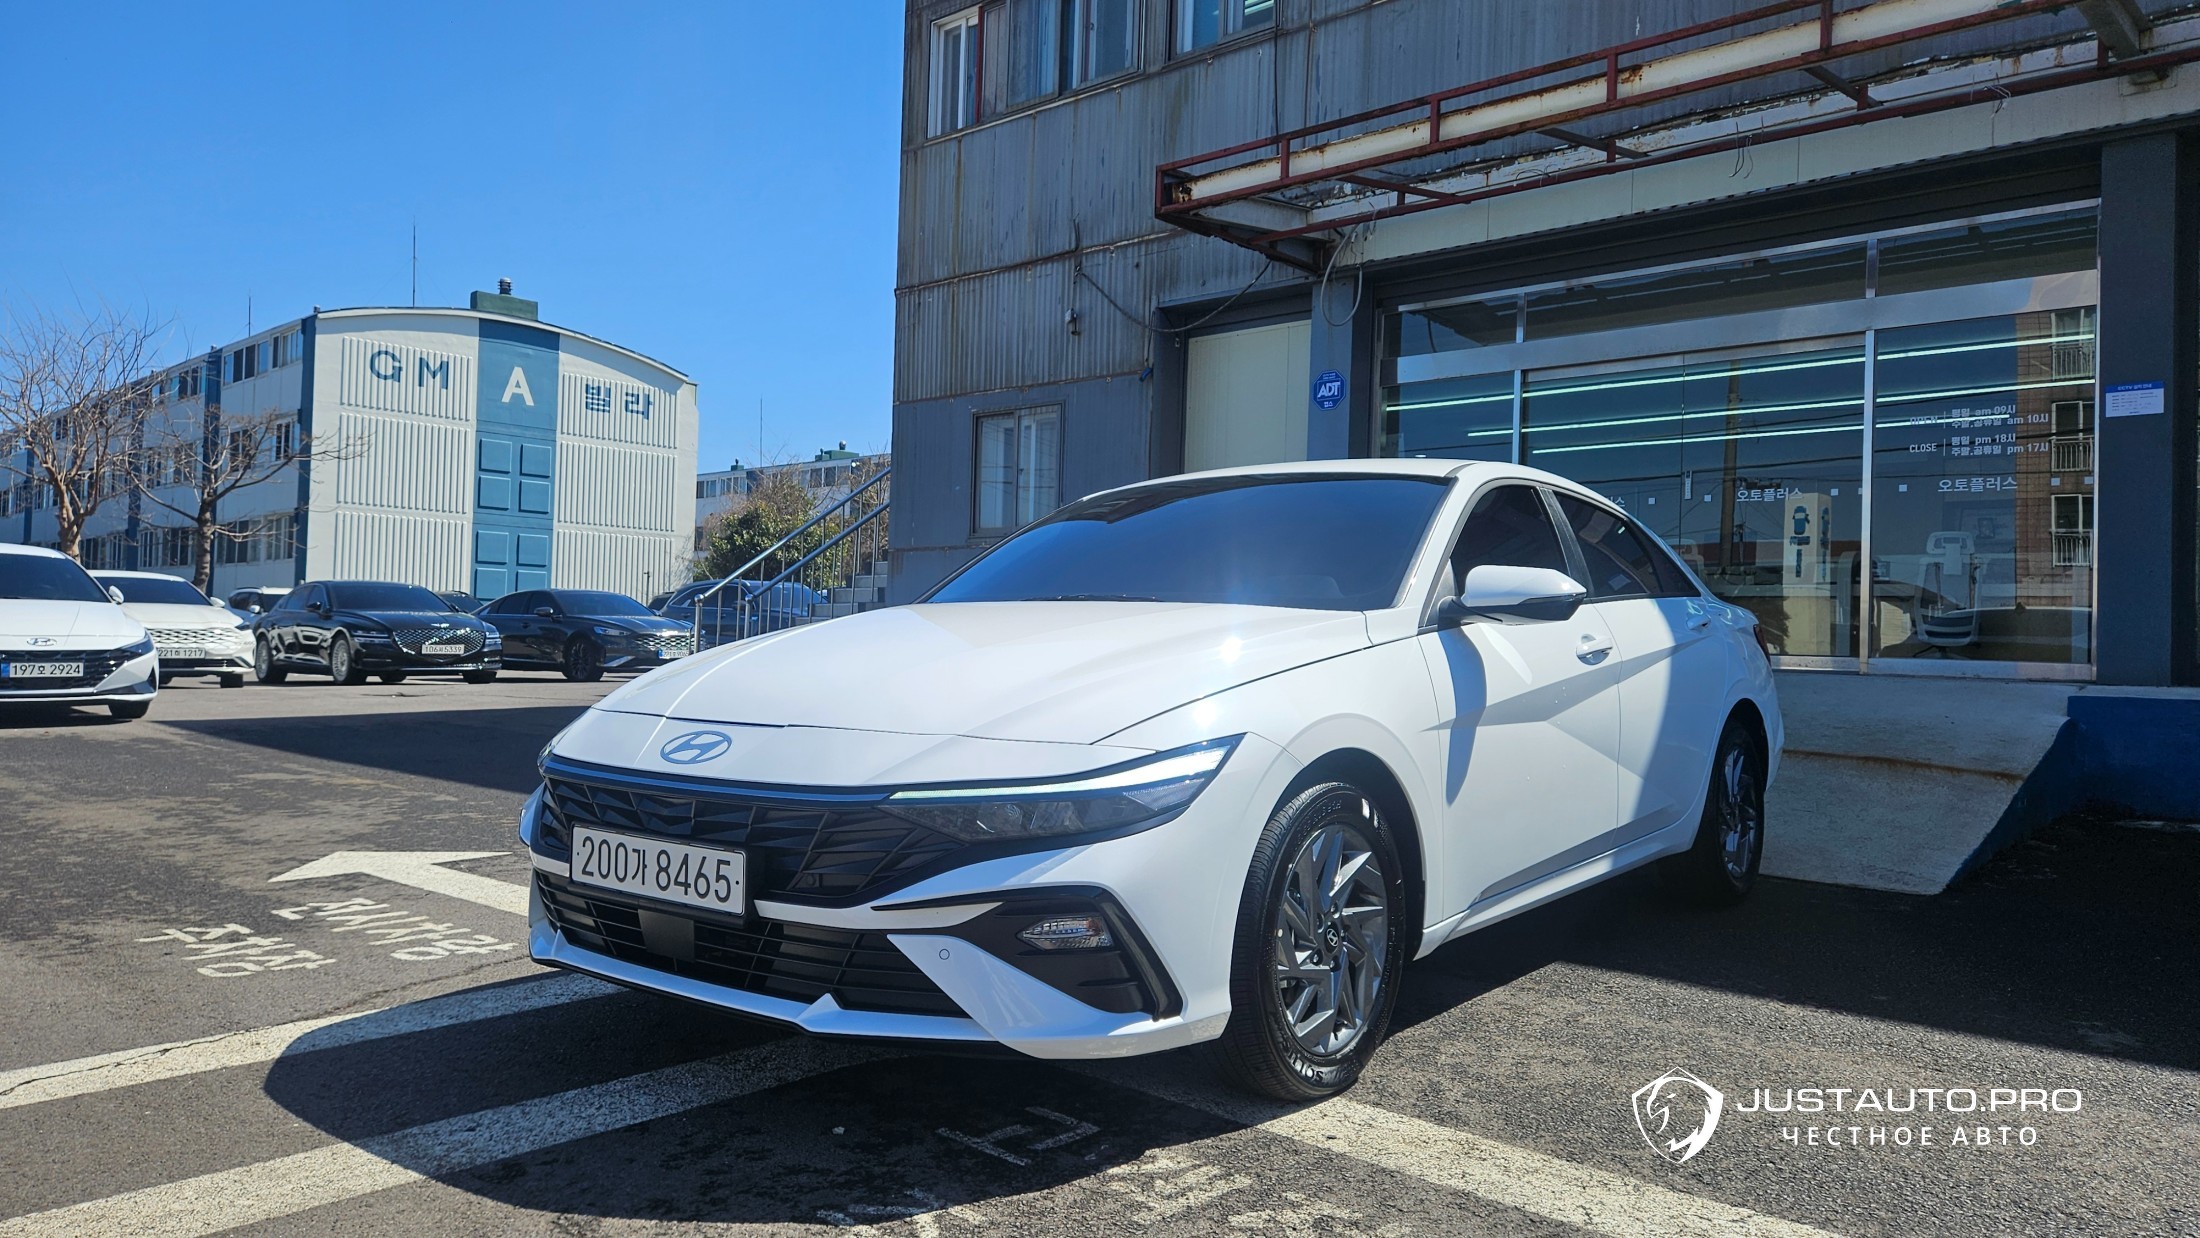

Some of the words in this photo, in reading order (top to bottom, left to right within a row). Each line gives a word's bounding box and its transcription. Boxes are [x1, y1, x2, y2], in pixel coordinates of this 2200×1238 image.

[370, 350, 449, 391] GM
[501, 366, 534, 406] A
[585, 383, 653, 420] 빌라
[1317, 381, 1341, 398] ADT
[1952, 408, 1970, 418] 평일
[1994, 405, 2016, 414] 09시
[2007, 417, 2024, 425] am
[2027, 413, 2049, 423] 10시
[1951, 435, 1970, 446] 평일
[1975, 437, 1991, 446] pm
[1994, 433, 2016, 443] 18시
[1909, 443, 1938, 453] CLOSE
[2007, 446, 2024, 455] pm
[2027, 442, 2049, 453] 17시
[1937, 476, 2018, 493] 오토플러스
[1737, 487, 1803, 502] 오토플러스
[183, 649, 203, 657] 1217
[12, 664, 46, 675] 197호
[50, 664, 80, 675] 2924
[581, 836, 647, 886] 200가
[655, 849, 732, 903] 8465
[134, 923, 337, 978] 주차장
